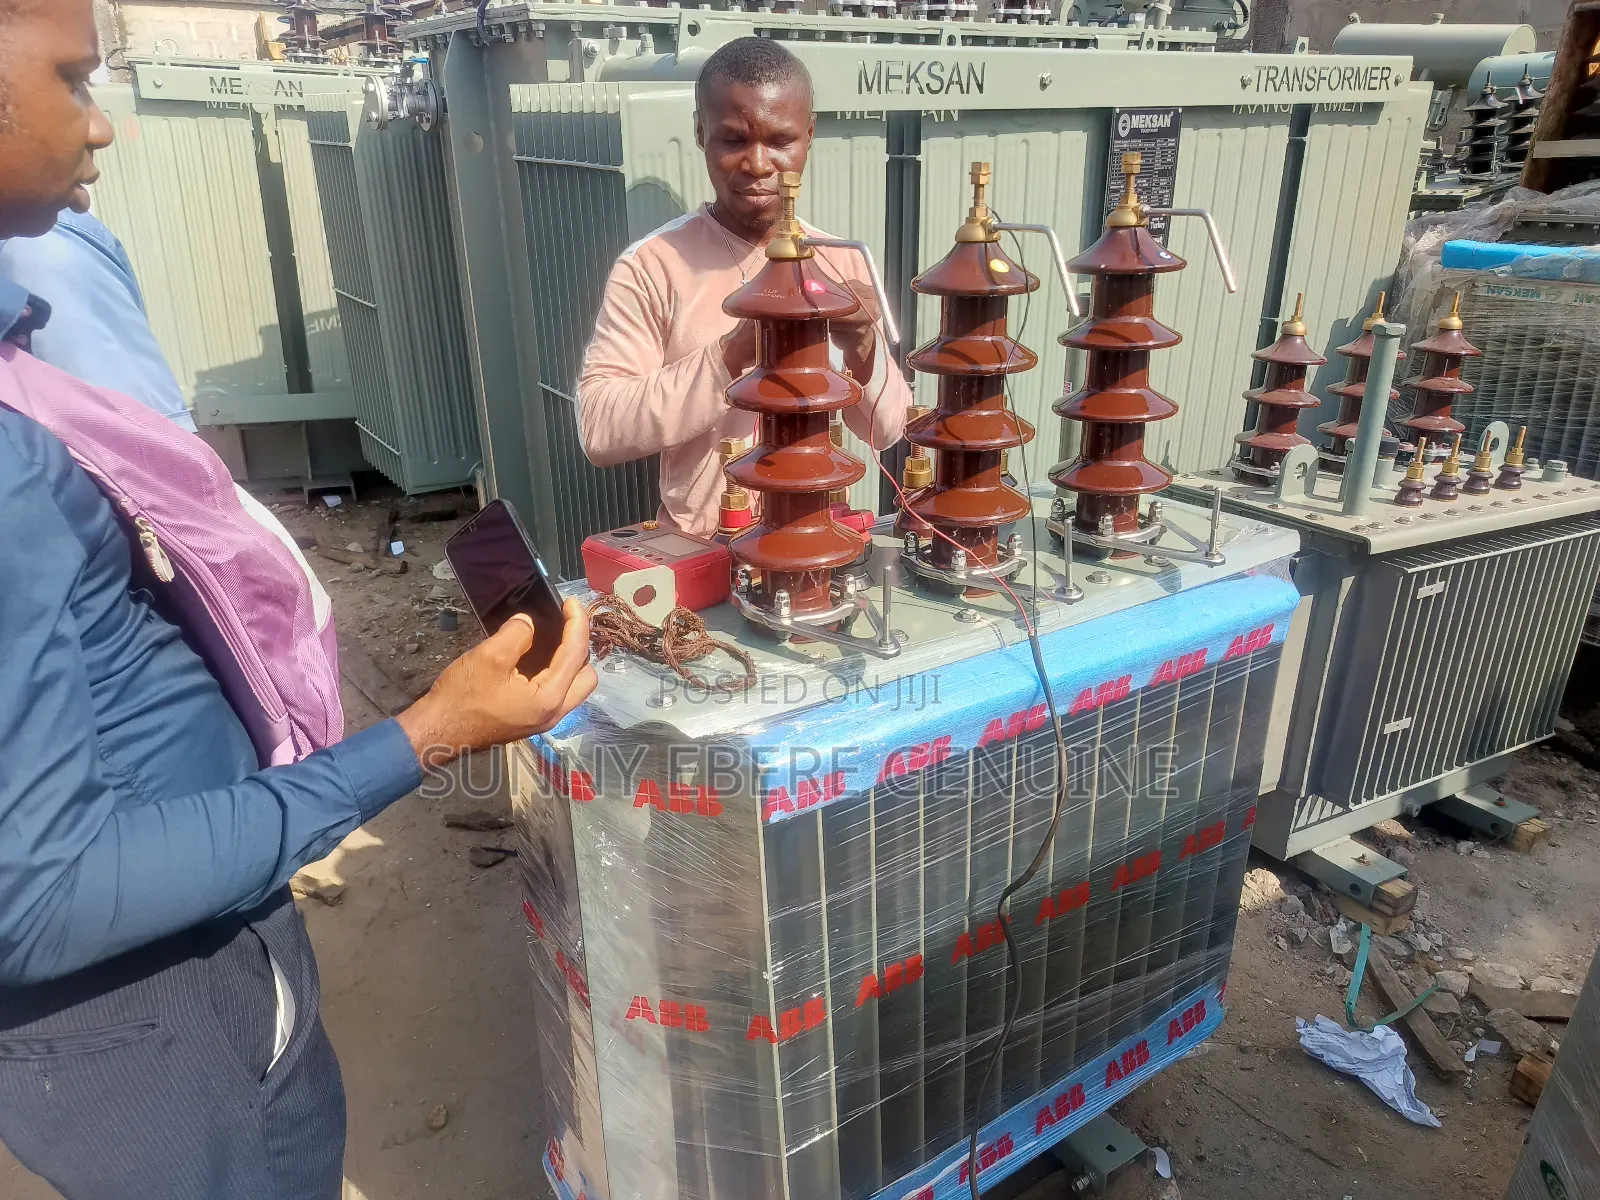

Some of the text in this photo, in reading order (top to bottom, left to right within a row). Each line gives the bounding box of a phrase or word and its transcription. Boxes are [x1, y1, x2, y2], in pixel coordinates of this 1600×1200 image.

[857, 60, 1392, 95] MEKSAN TRANSFORMER
[1131, 113, 1172, 129] MEKSAN
[761, 623, 1275, 822] ABB ABB ABB ABB ABB ABB
[633, 778, 723, 816] ABB
[625, 995, 710, 1033] ABB
[746, 996, 827, 1044] ABB
[855, 953, 924, 1009] ABB
[1036, 1082, 1087, 1136] ABB
[1105, 1039, 1150, 1089] ABB
[1168, 999, 1207, 1047] ABB
